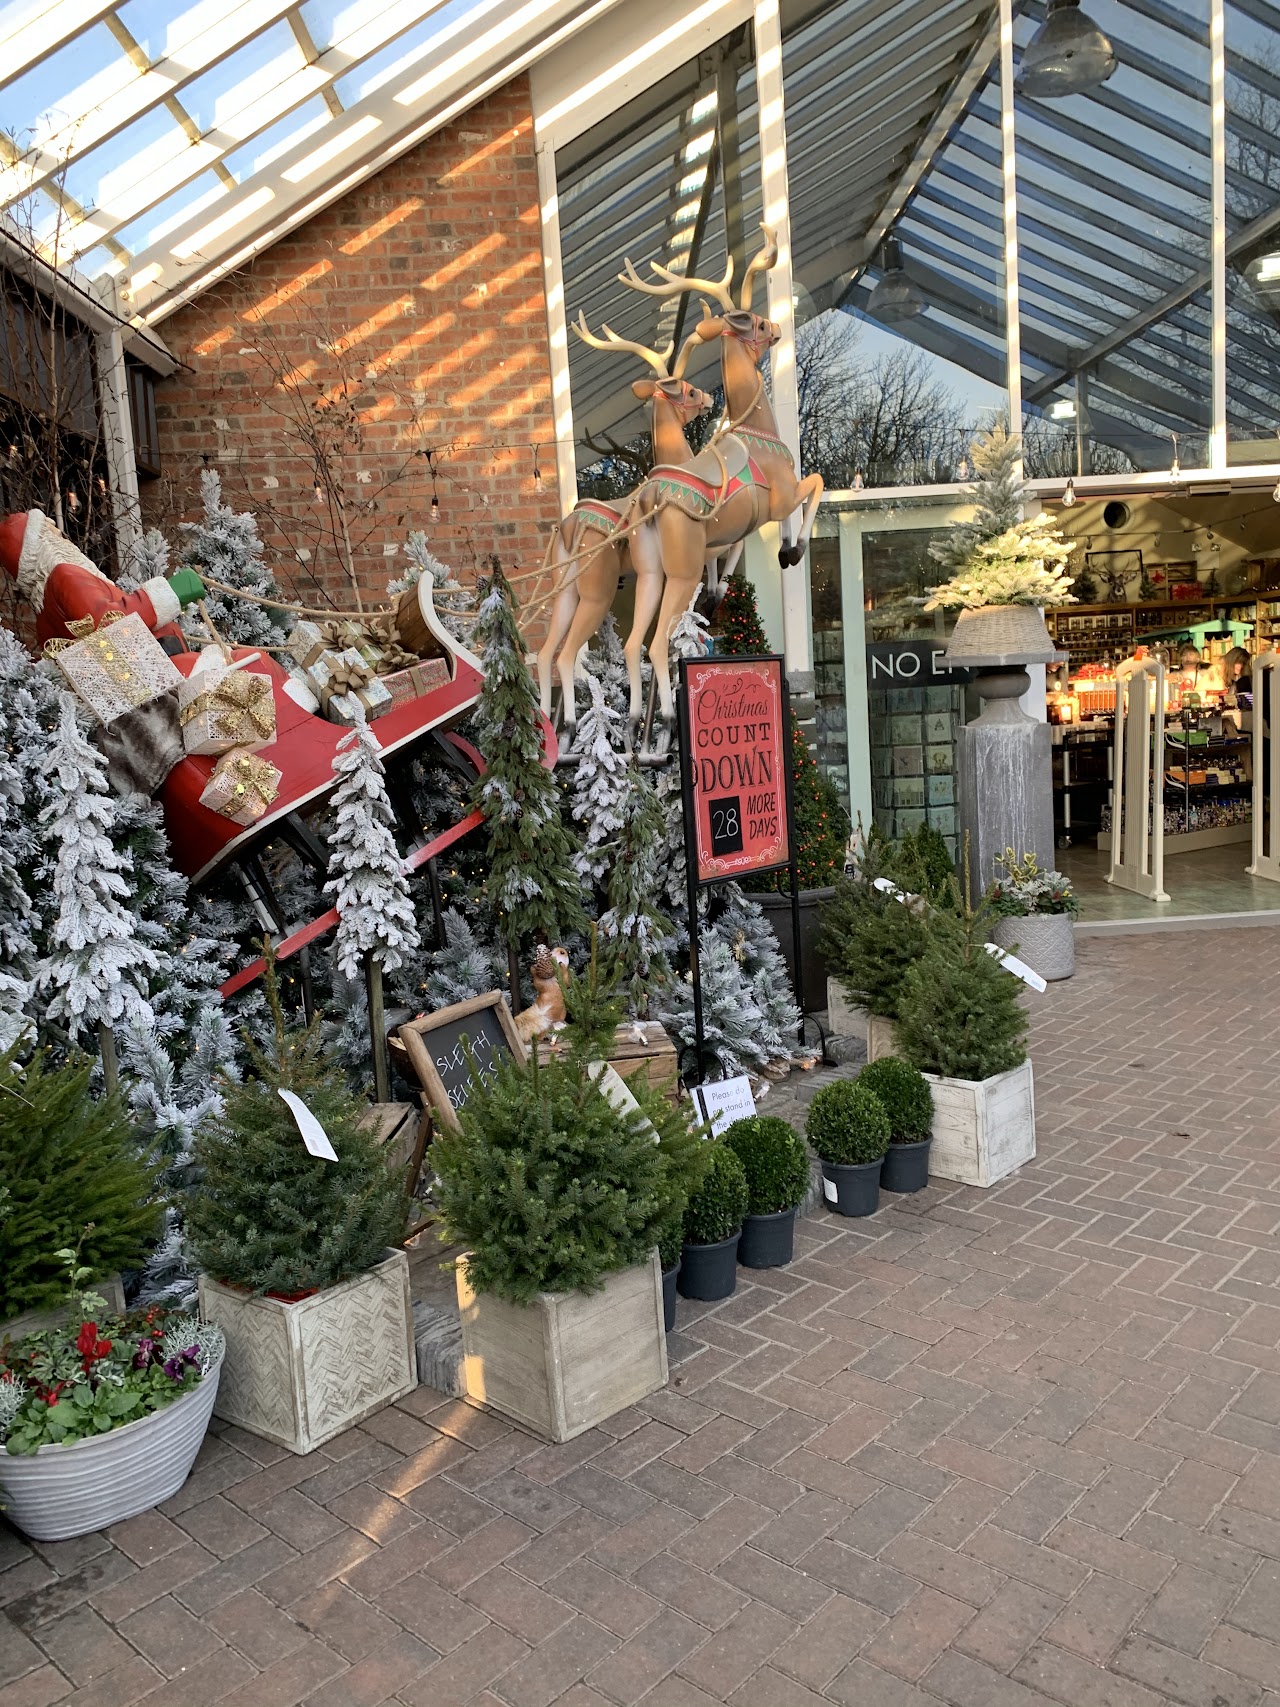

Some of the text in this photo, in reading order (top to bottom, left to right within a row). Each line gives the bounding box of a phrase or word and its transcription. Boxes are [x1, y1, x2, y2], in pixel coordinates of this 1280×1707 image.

[872, 652, 920, 679] NO
[697, 690, 769, 724] Christmas
[697, 722, 771, 748] COUNT
[701, 746, 773, 794] DOWN
[746, 792, 777, 816] MORE
[712, 807, 740, 840] 28
[749, 816, 778, 840] DAYS
[711, 1085, 745, 1101] Please do
[724, 1099, 743, 1113] stand
[744, 1099, 751, 1108] in
[716, 1121, 728, 1131] the
